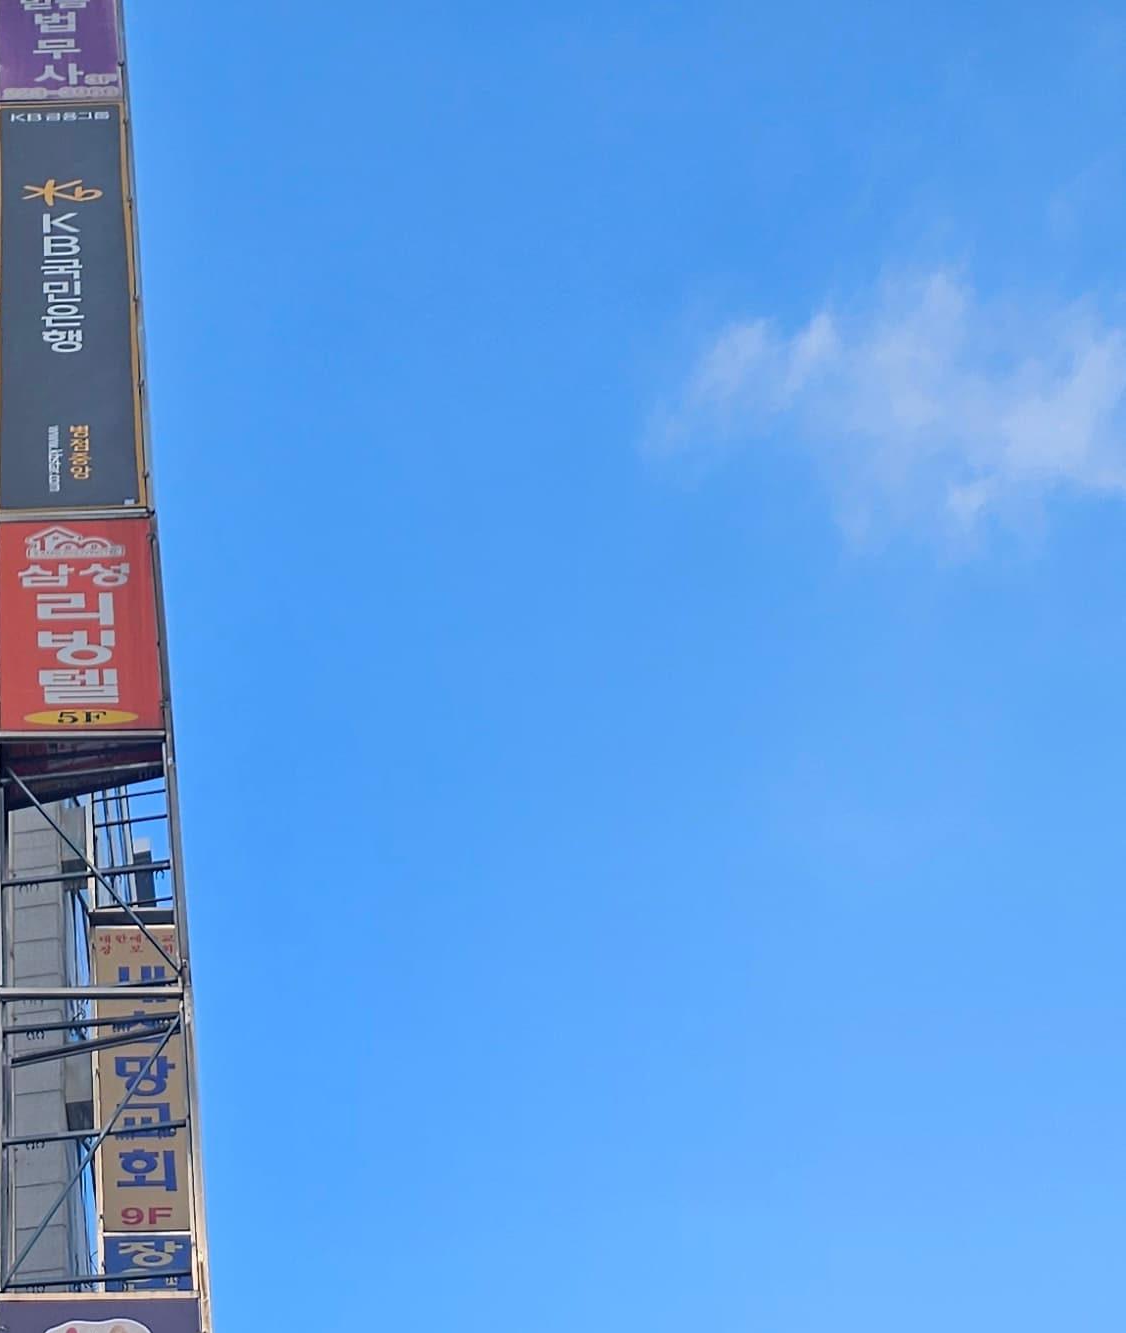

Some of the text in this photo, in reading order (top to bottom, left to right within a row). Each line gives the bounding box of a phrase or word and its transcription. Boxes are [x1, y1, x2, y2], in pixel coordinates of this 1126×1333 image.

[33, 11, 84, 86] 법무사
[40, 213, 85, 354] KB국민은행
[17, 562, 131, 588] 삼성
[35, 591, 120, 705] 리빙텔
[57, 711, 107, 725] 5F
[120, 1206, 174, 1226] 9F
